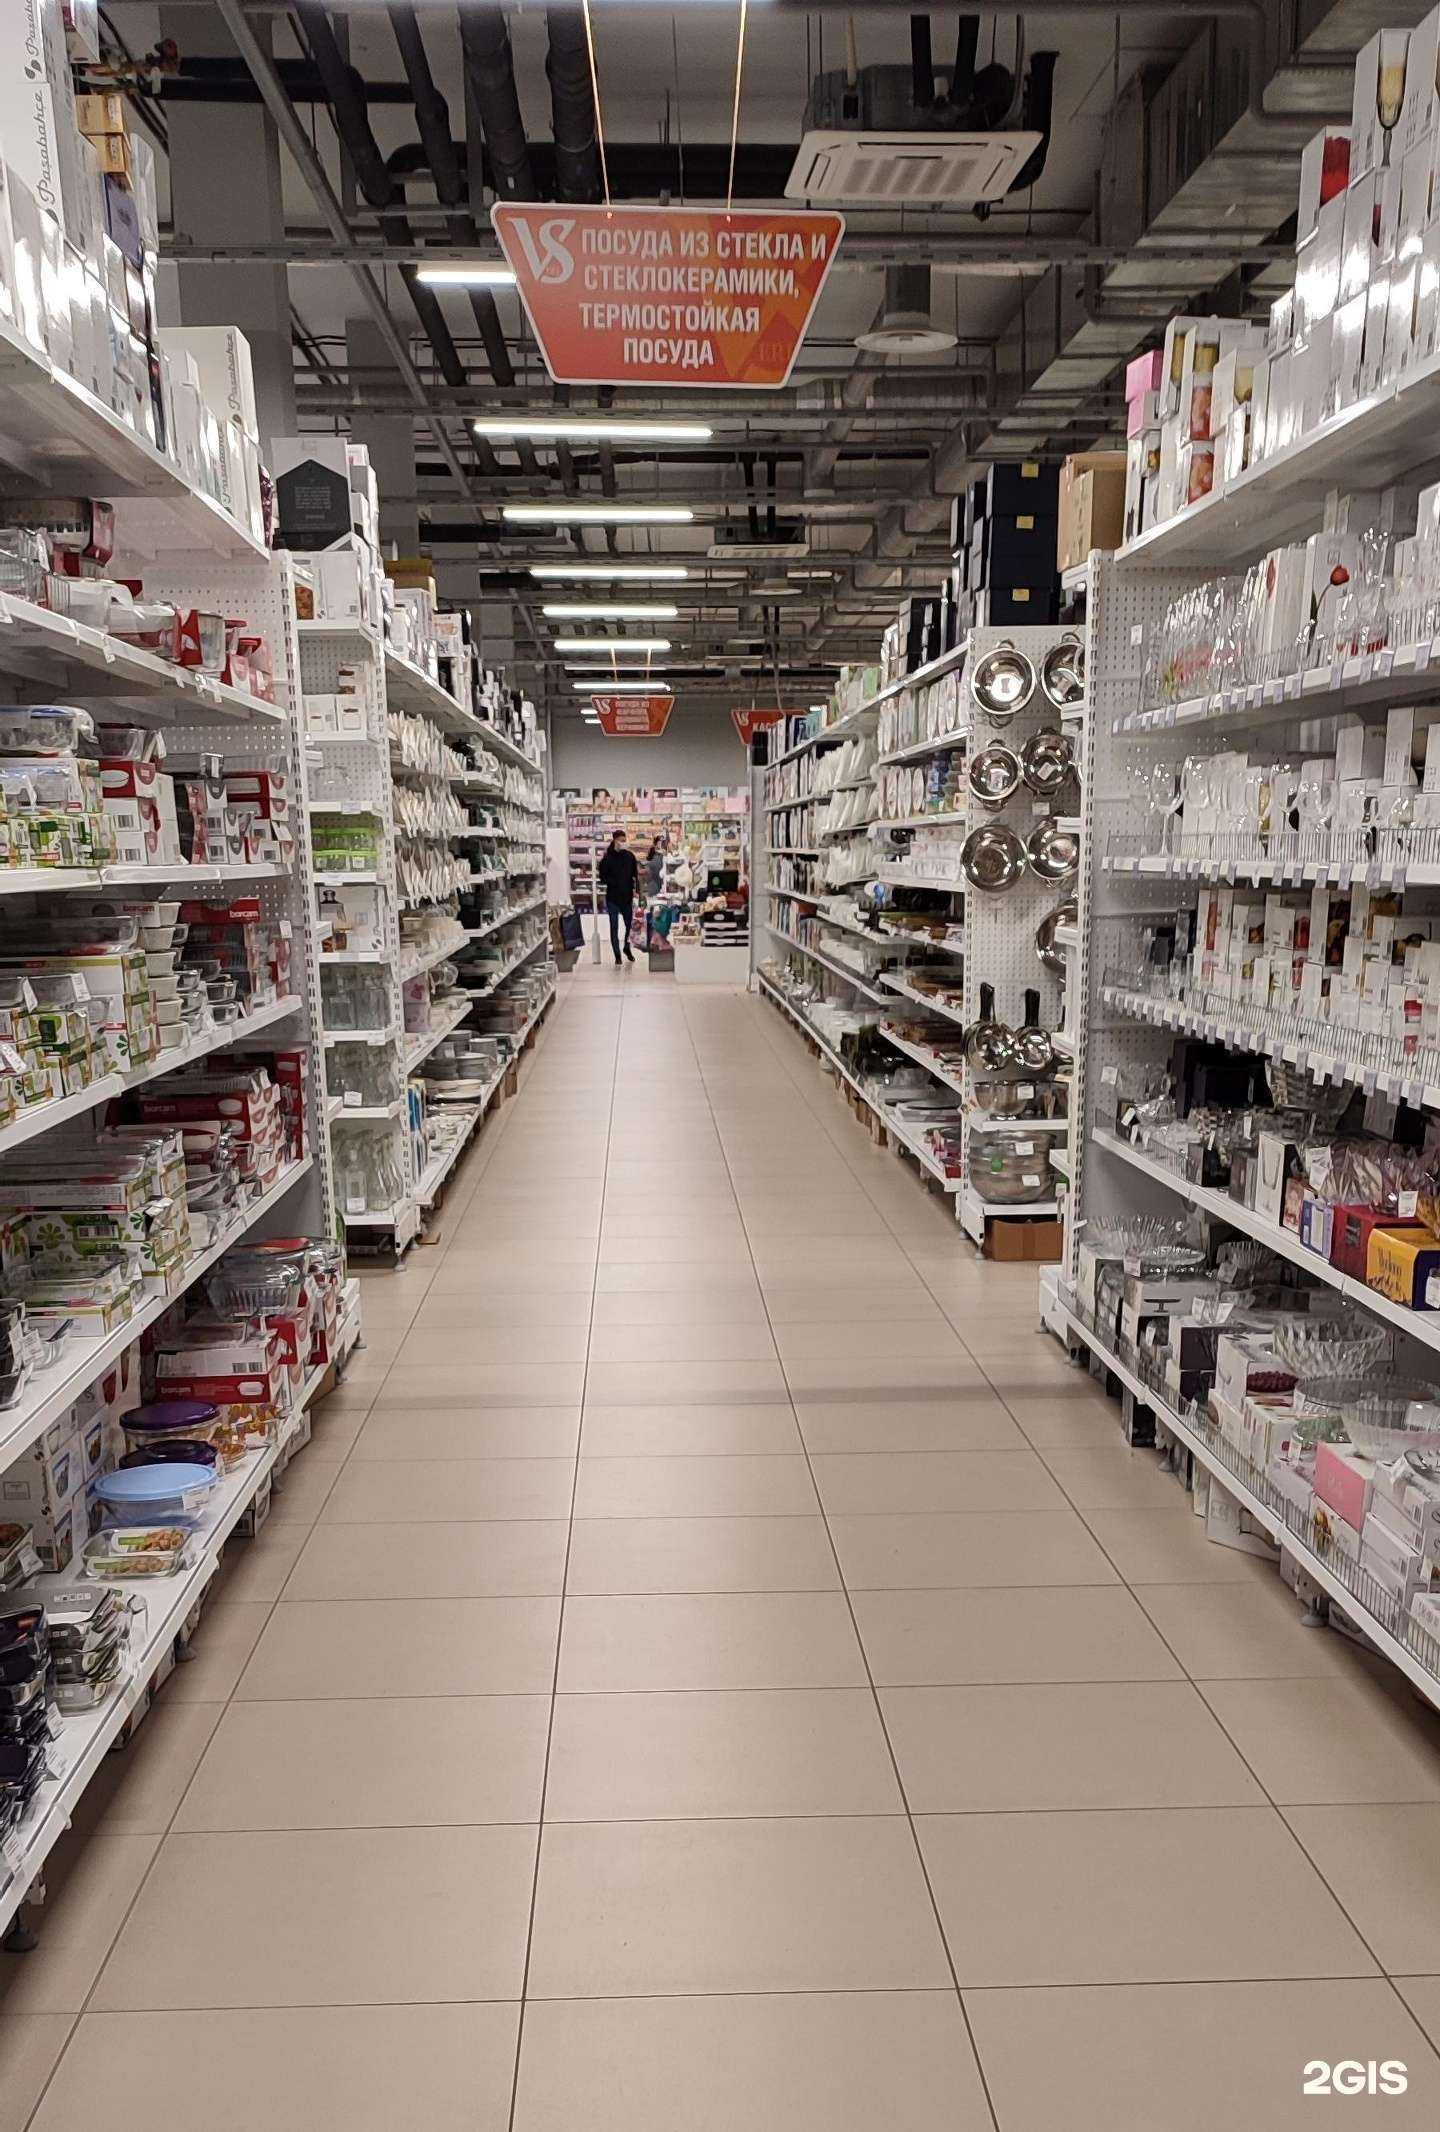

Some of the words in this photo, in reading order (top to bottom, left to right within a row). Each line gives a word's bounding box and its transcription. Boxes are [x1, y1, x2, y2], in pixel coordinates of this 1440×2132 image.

[506, 217, 577, 284] VS
[582, 228, 673, 260] ПОСУДА
[680, 231, 710, 256] ИЗ
[716, 231, 804, 260] СТЕКЛА
[811, 234, 827, 260] И
[584, 264, 801, 298] СТЕКЛОКЕРАМИКИ,
[579, 300, 761, 333] ТЕРМОСТОЙКАЯ
[623, 338, 715, 369] ПОСУДА
[229, 909, 260, 919] borcam
